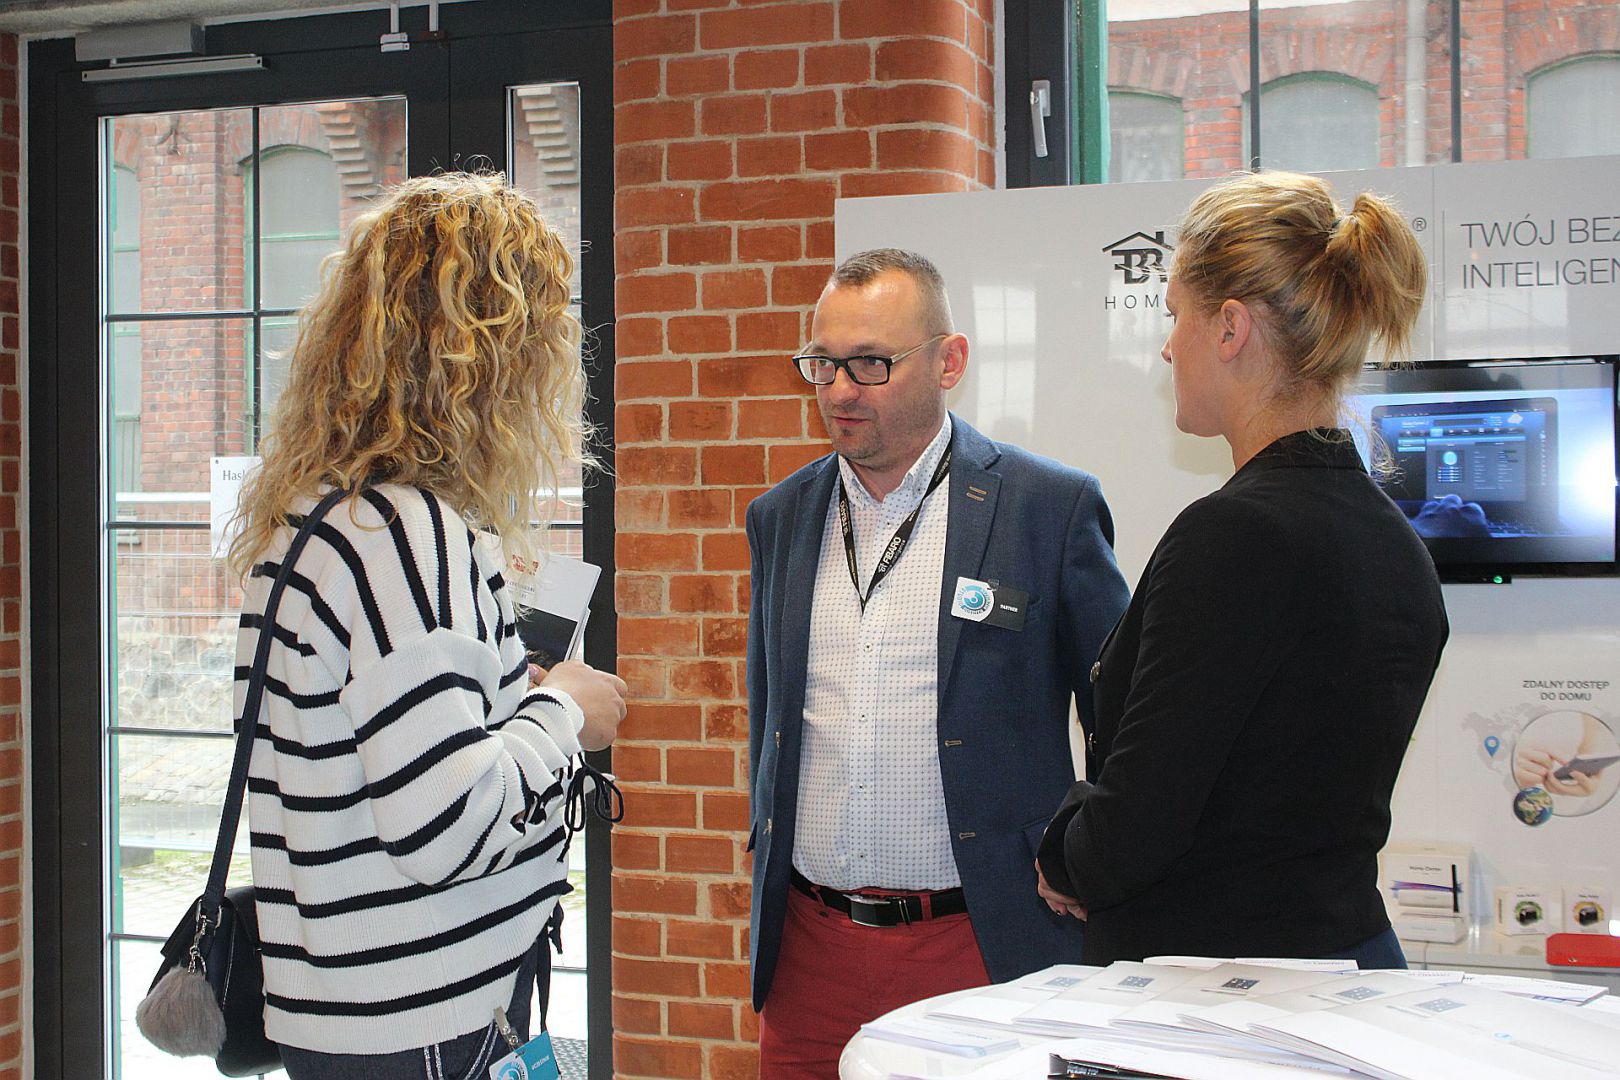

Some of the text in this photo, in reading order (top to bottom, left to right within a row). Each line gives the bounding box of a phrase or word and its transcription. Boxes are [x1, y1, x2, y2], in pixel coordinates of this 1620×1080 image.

[1460, 213, 1555, 249] TWÓJ
[1104, 294, 1160, 310] HOM
[883, 536, 902, 565] FIBARO
[1522, 680, 1565, 689] ZDALNY
[1540, 692, 1592, 701] DO DOMU
